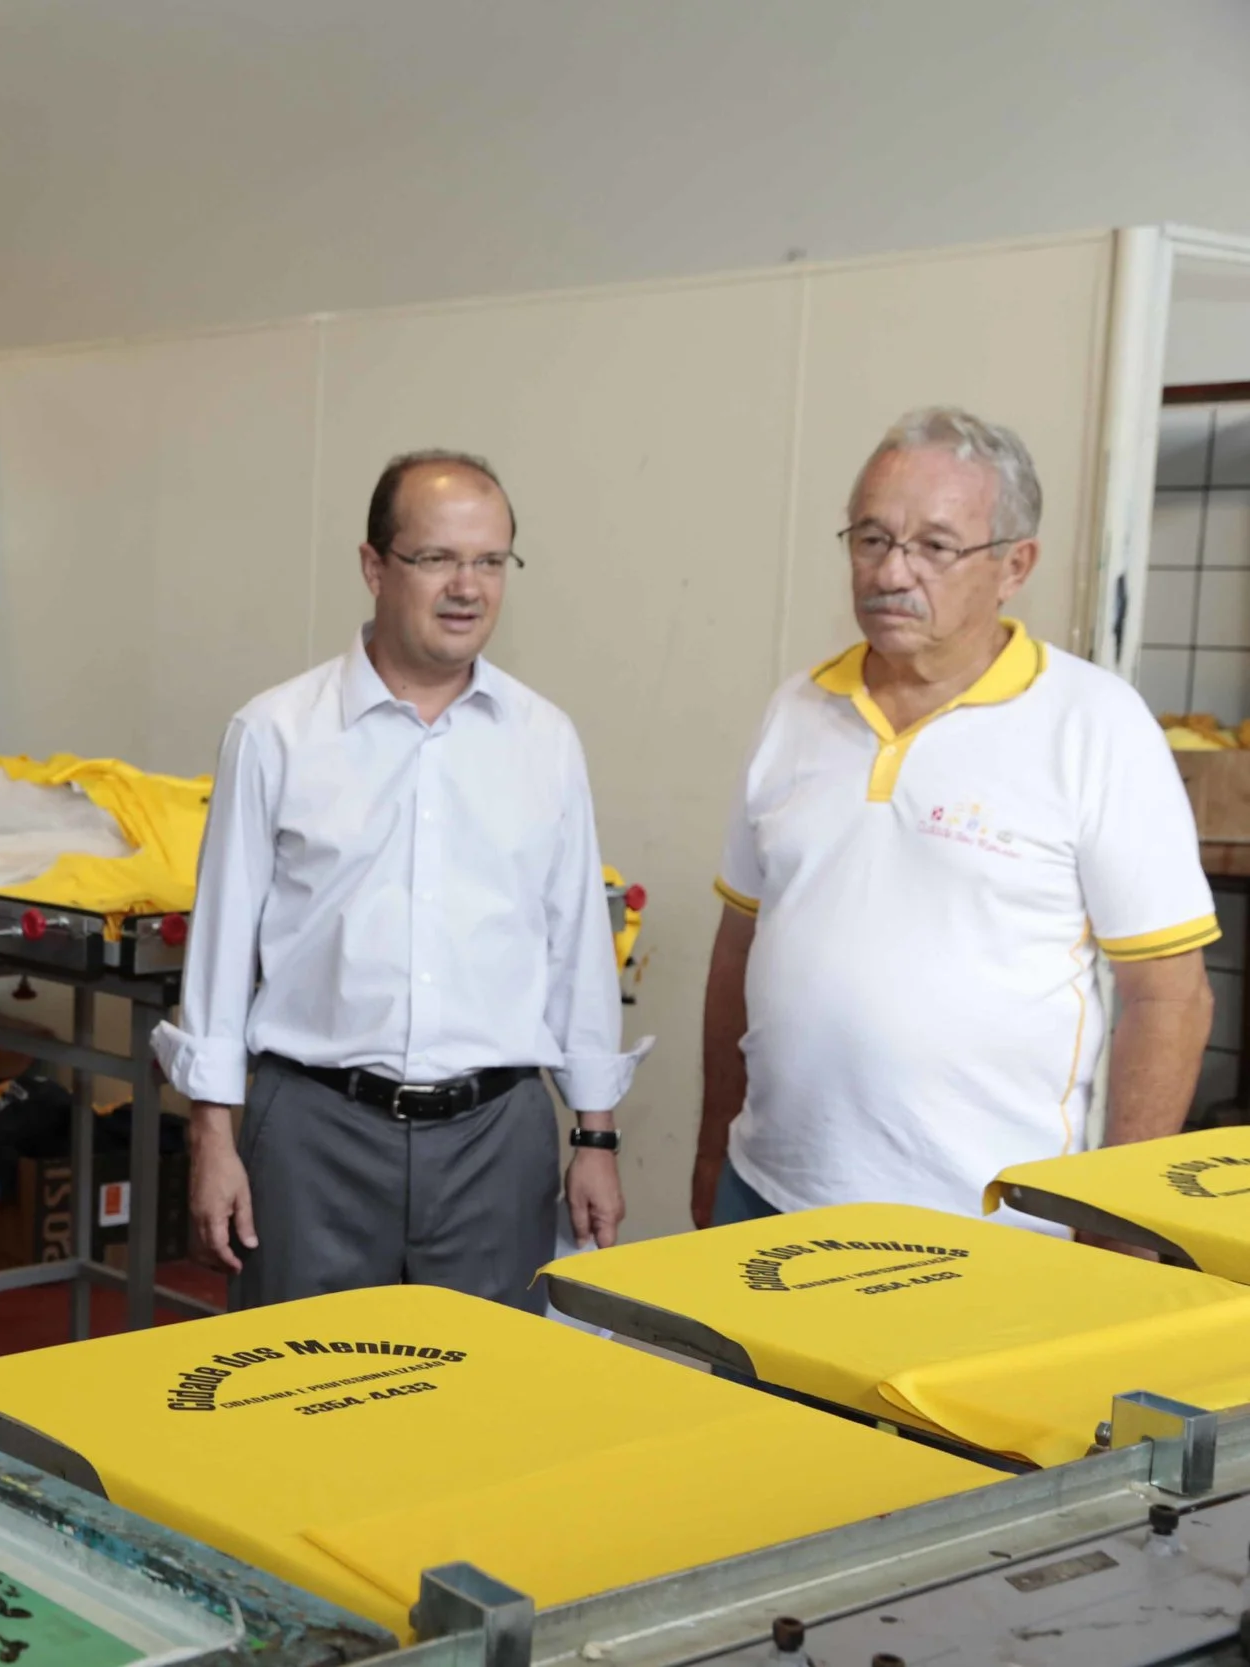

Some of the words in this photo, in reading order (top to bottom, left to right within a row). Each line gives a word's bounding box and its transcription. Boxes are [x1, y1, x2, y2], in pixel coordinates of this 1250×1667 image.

[755, 1244, 817, 1260] dos
[808, 1239, 970, 1258] Meninos
[738, 1258, 791, 1291] Cidade
[855, 1271, 963, 1295] 3354-4433
[167, 1366, 232, 1411] Cidade
[211, 1347, 285, 1369] dos
[283, 1339, 468, 1363] Meninos
[219, 1390, 299, 1409] CIDADANIA
[307, 1360, 446, 1393] PROFISSIONALIZAÇÃO
[294, 1381, 439, 1416] 3354-4433
